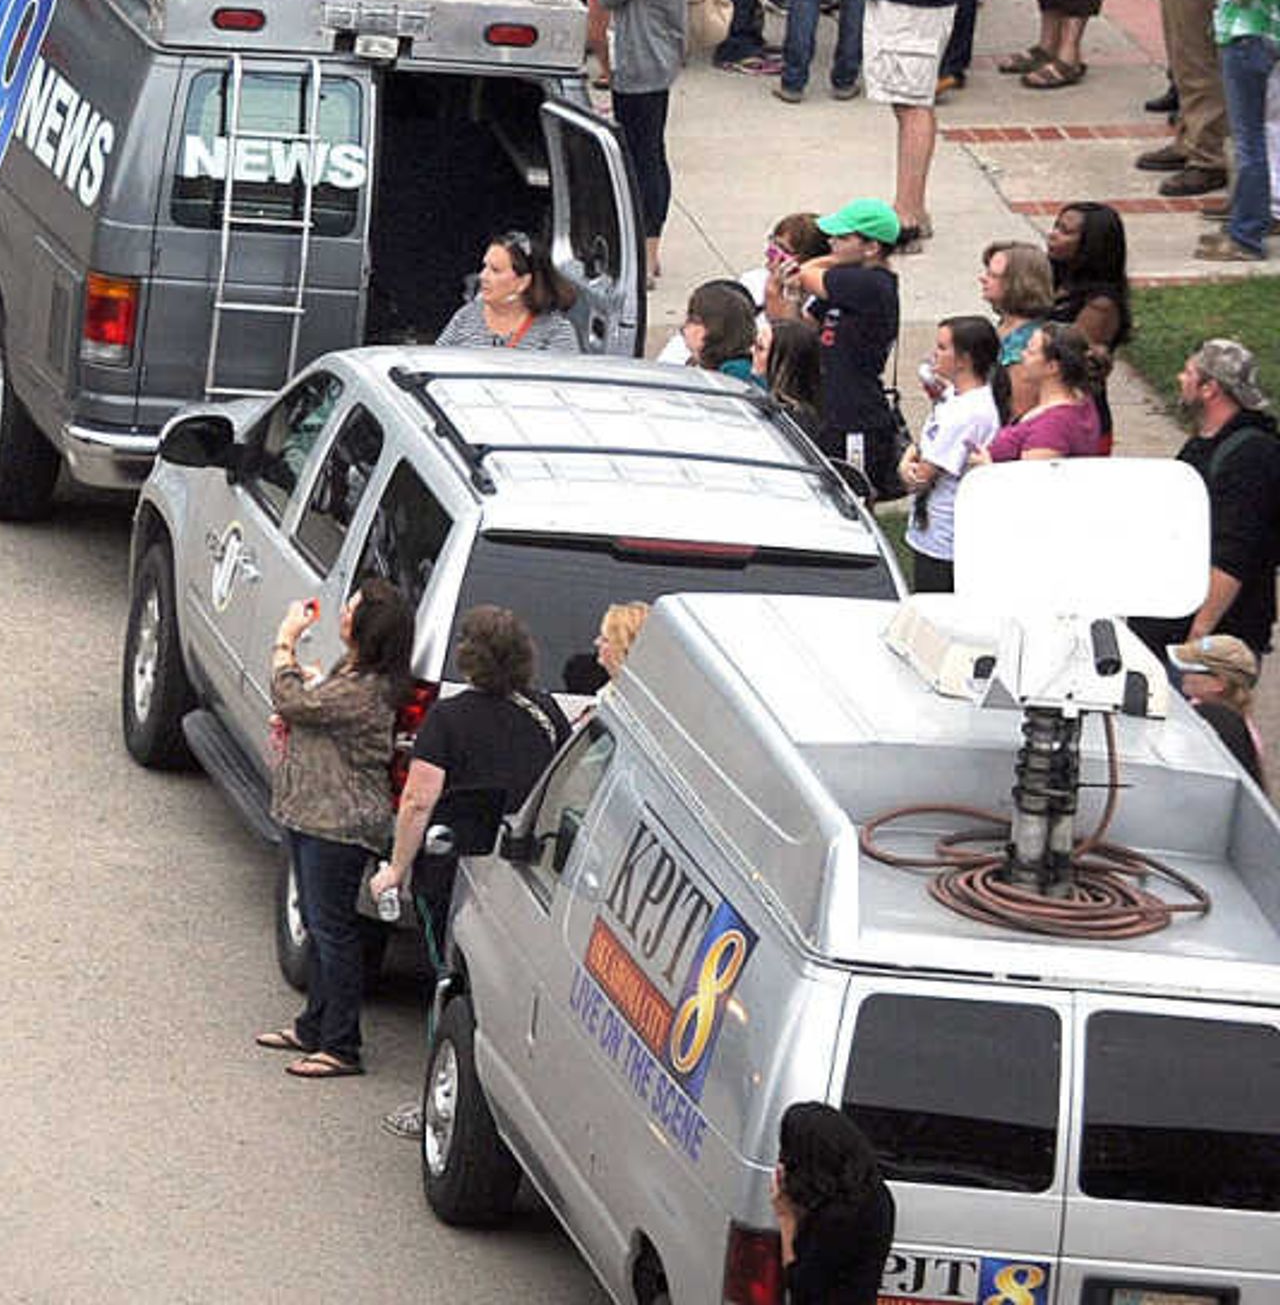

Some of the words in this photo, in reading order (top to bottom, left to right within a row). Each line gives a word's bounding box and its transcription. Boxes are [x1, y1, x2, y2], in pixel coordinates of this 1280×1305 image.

[15, 57, 116, 208] NEWS
[183, 134, 368, 190] NEWS
[605, 819, 715, 988] KPJT
[671, 929, 746, 1074] 8
[570, 964, 601, 1036] LIVE
[599, 1012, 625, 1063] ON
[624, 1038, 652, 1098] THE
[649, 1074, 708, 1165] SCENE
[883, 1252, 978, 1297] PJT
[983, 1263, 1046, 1305] 8
